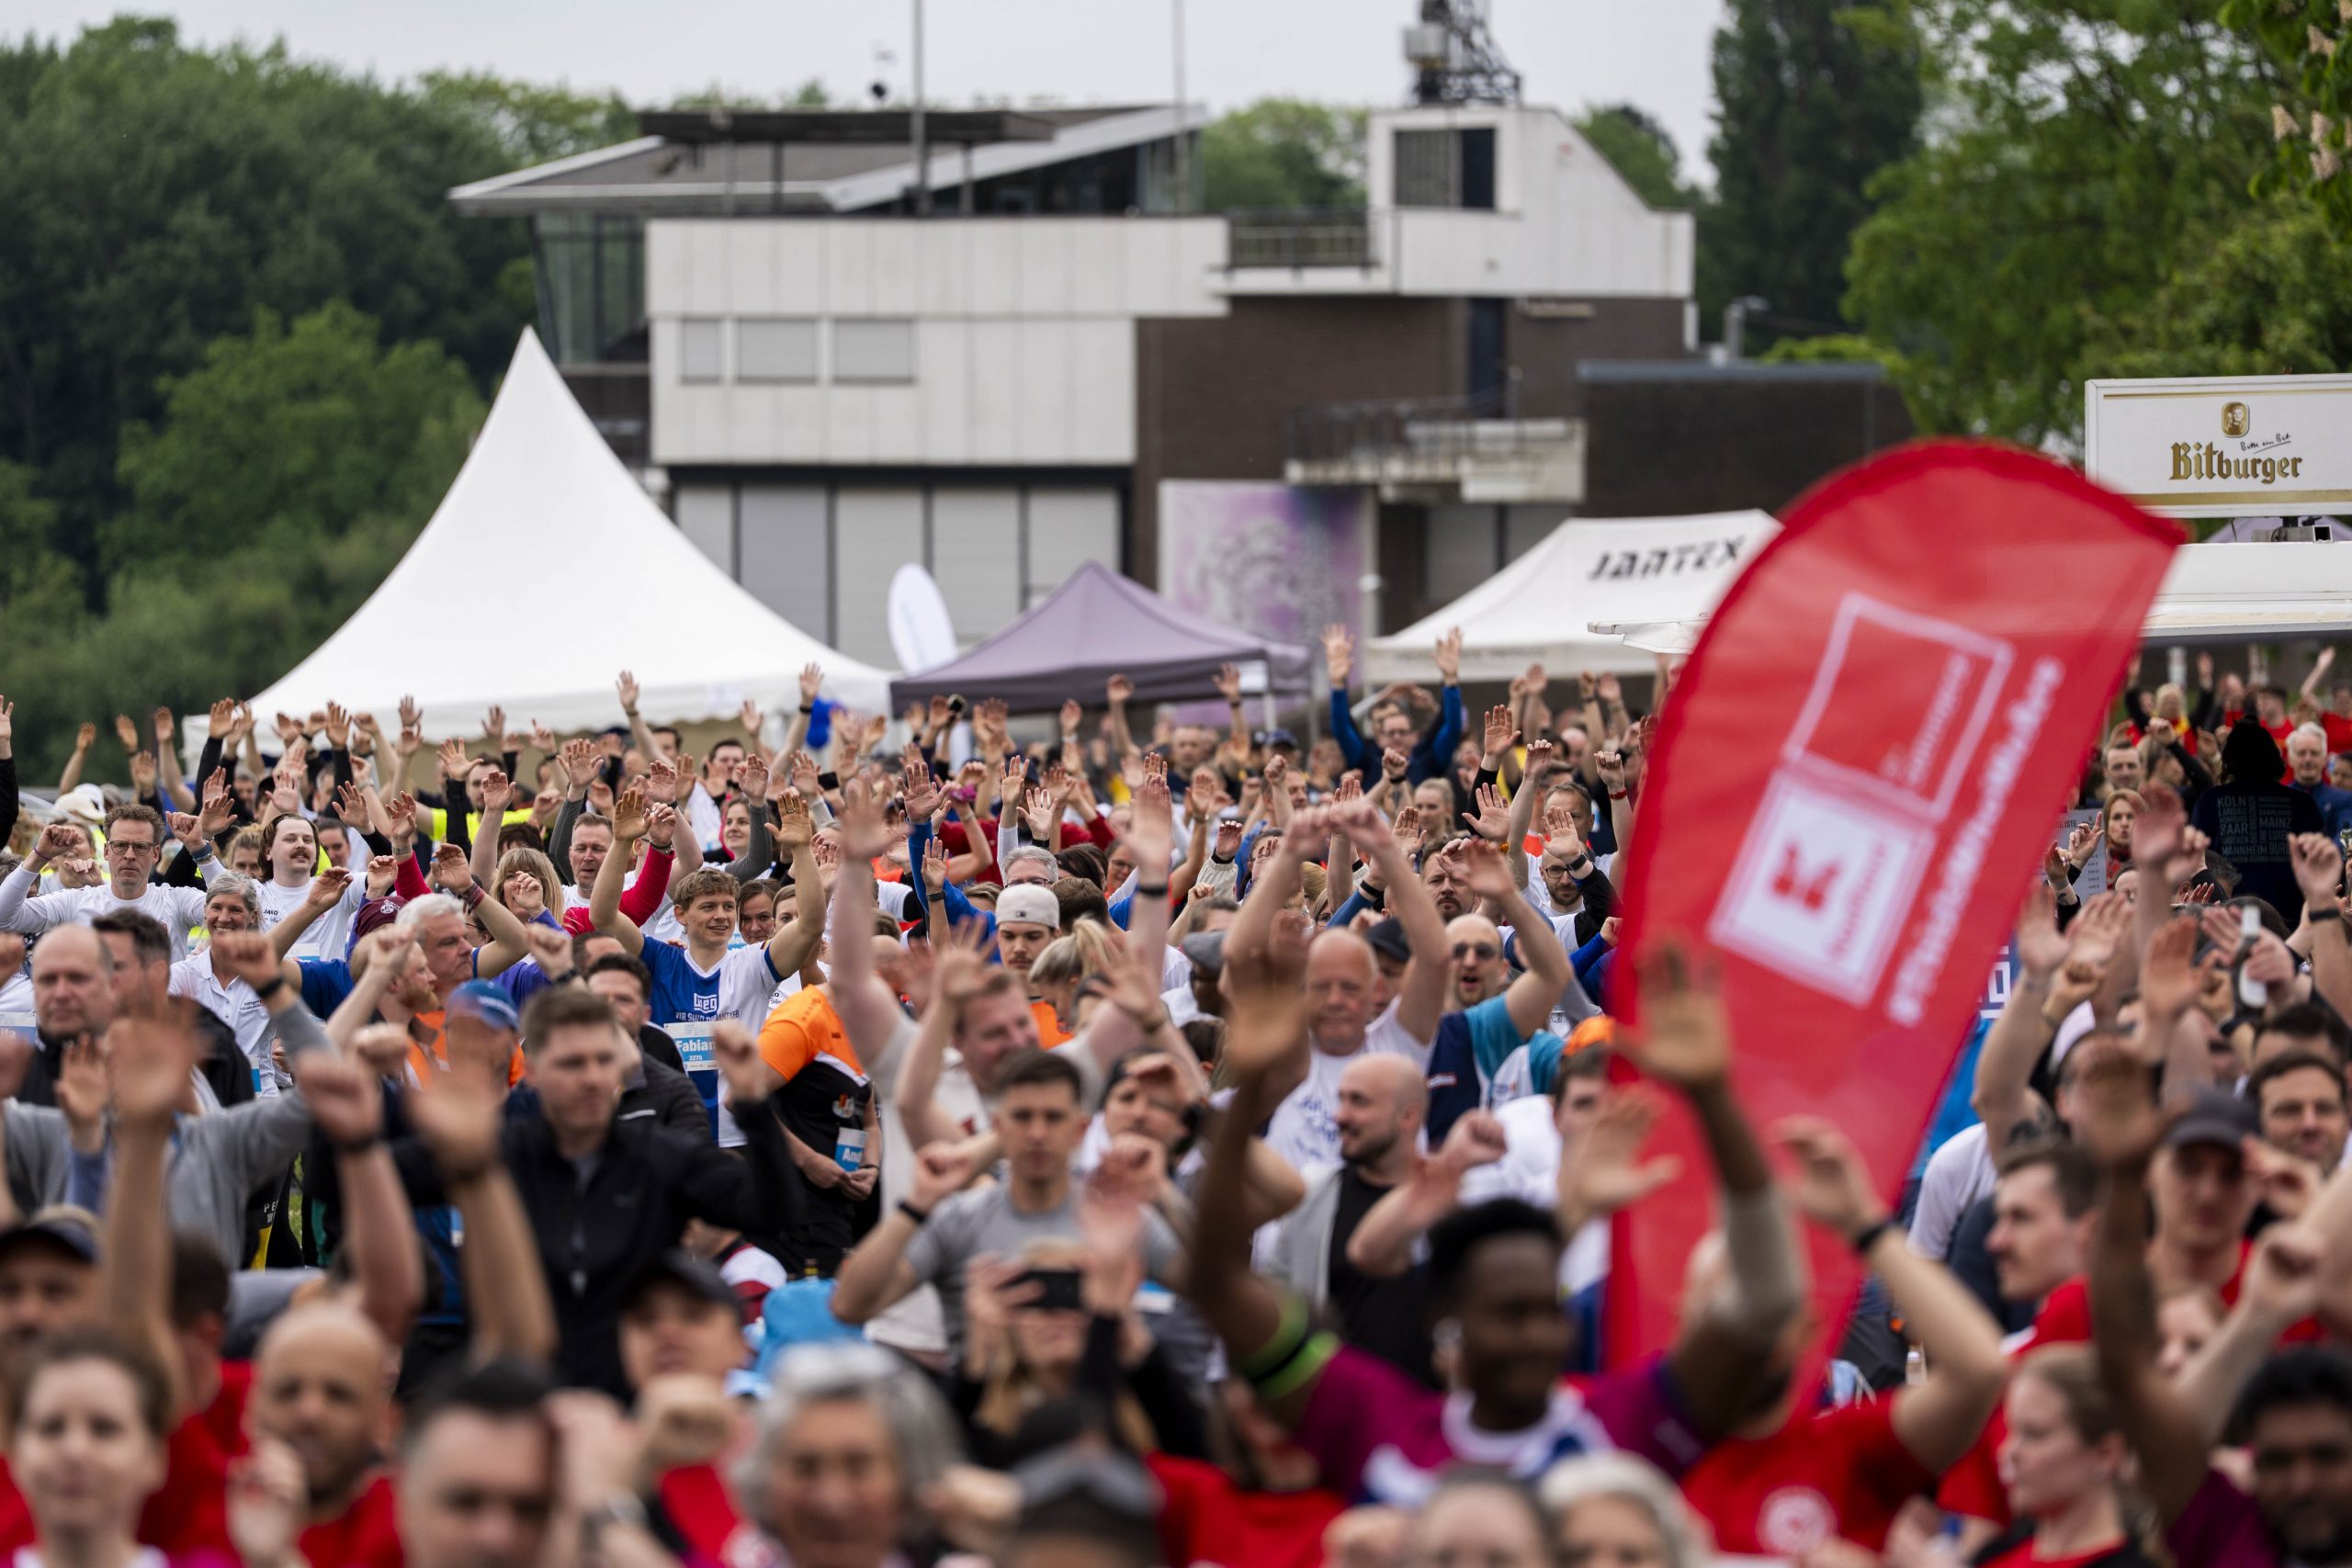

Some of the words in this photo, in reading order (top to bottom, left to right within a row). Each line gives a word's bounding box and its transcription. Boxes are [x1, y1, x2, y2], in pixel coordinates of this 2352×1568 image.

[2240, 441, 2260, 452] Bitte
[2276, 434, 2291, 443] Bit
[2168, 441, 2302, 484] Bitburger
[2217, 795, 2246, 807] KÖLN
[2259, 816, 2292, 829] MAINZ
[675, 1039, 716, 1052] Fabian
